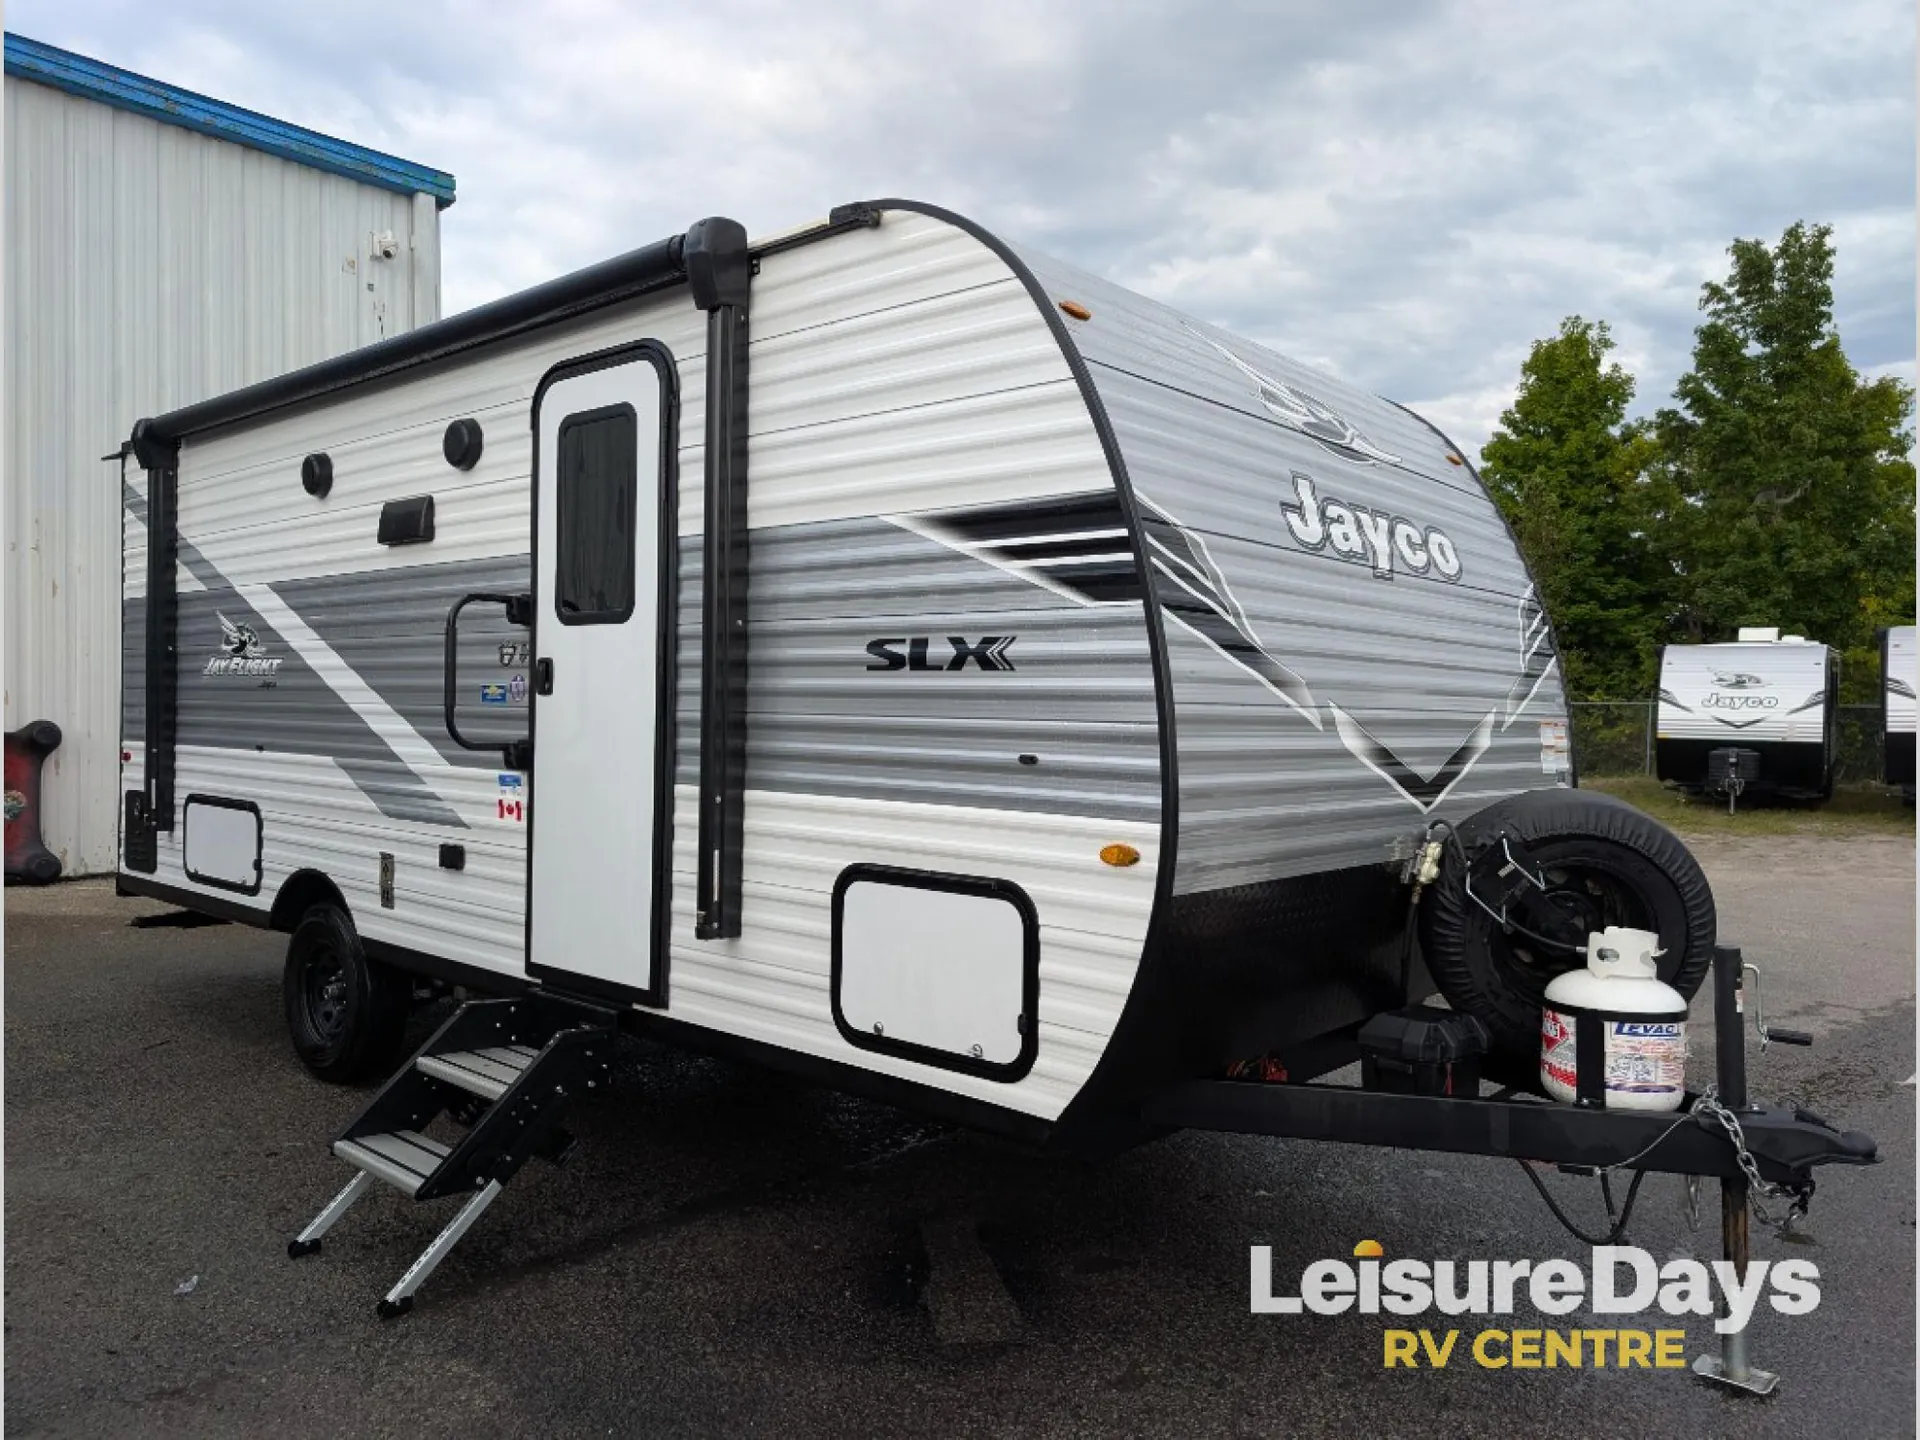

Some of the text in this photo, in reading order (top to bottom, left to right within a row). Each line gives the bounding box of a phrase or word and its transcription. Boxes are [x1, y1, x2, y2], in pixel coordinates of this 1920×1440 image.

[1281, 472, 1462, 580] Jayco
[866, 636, 1017, 671] SLX
[1701, 692, 1778, 710] Jayco
